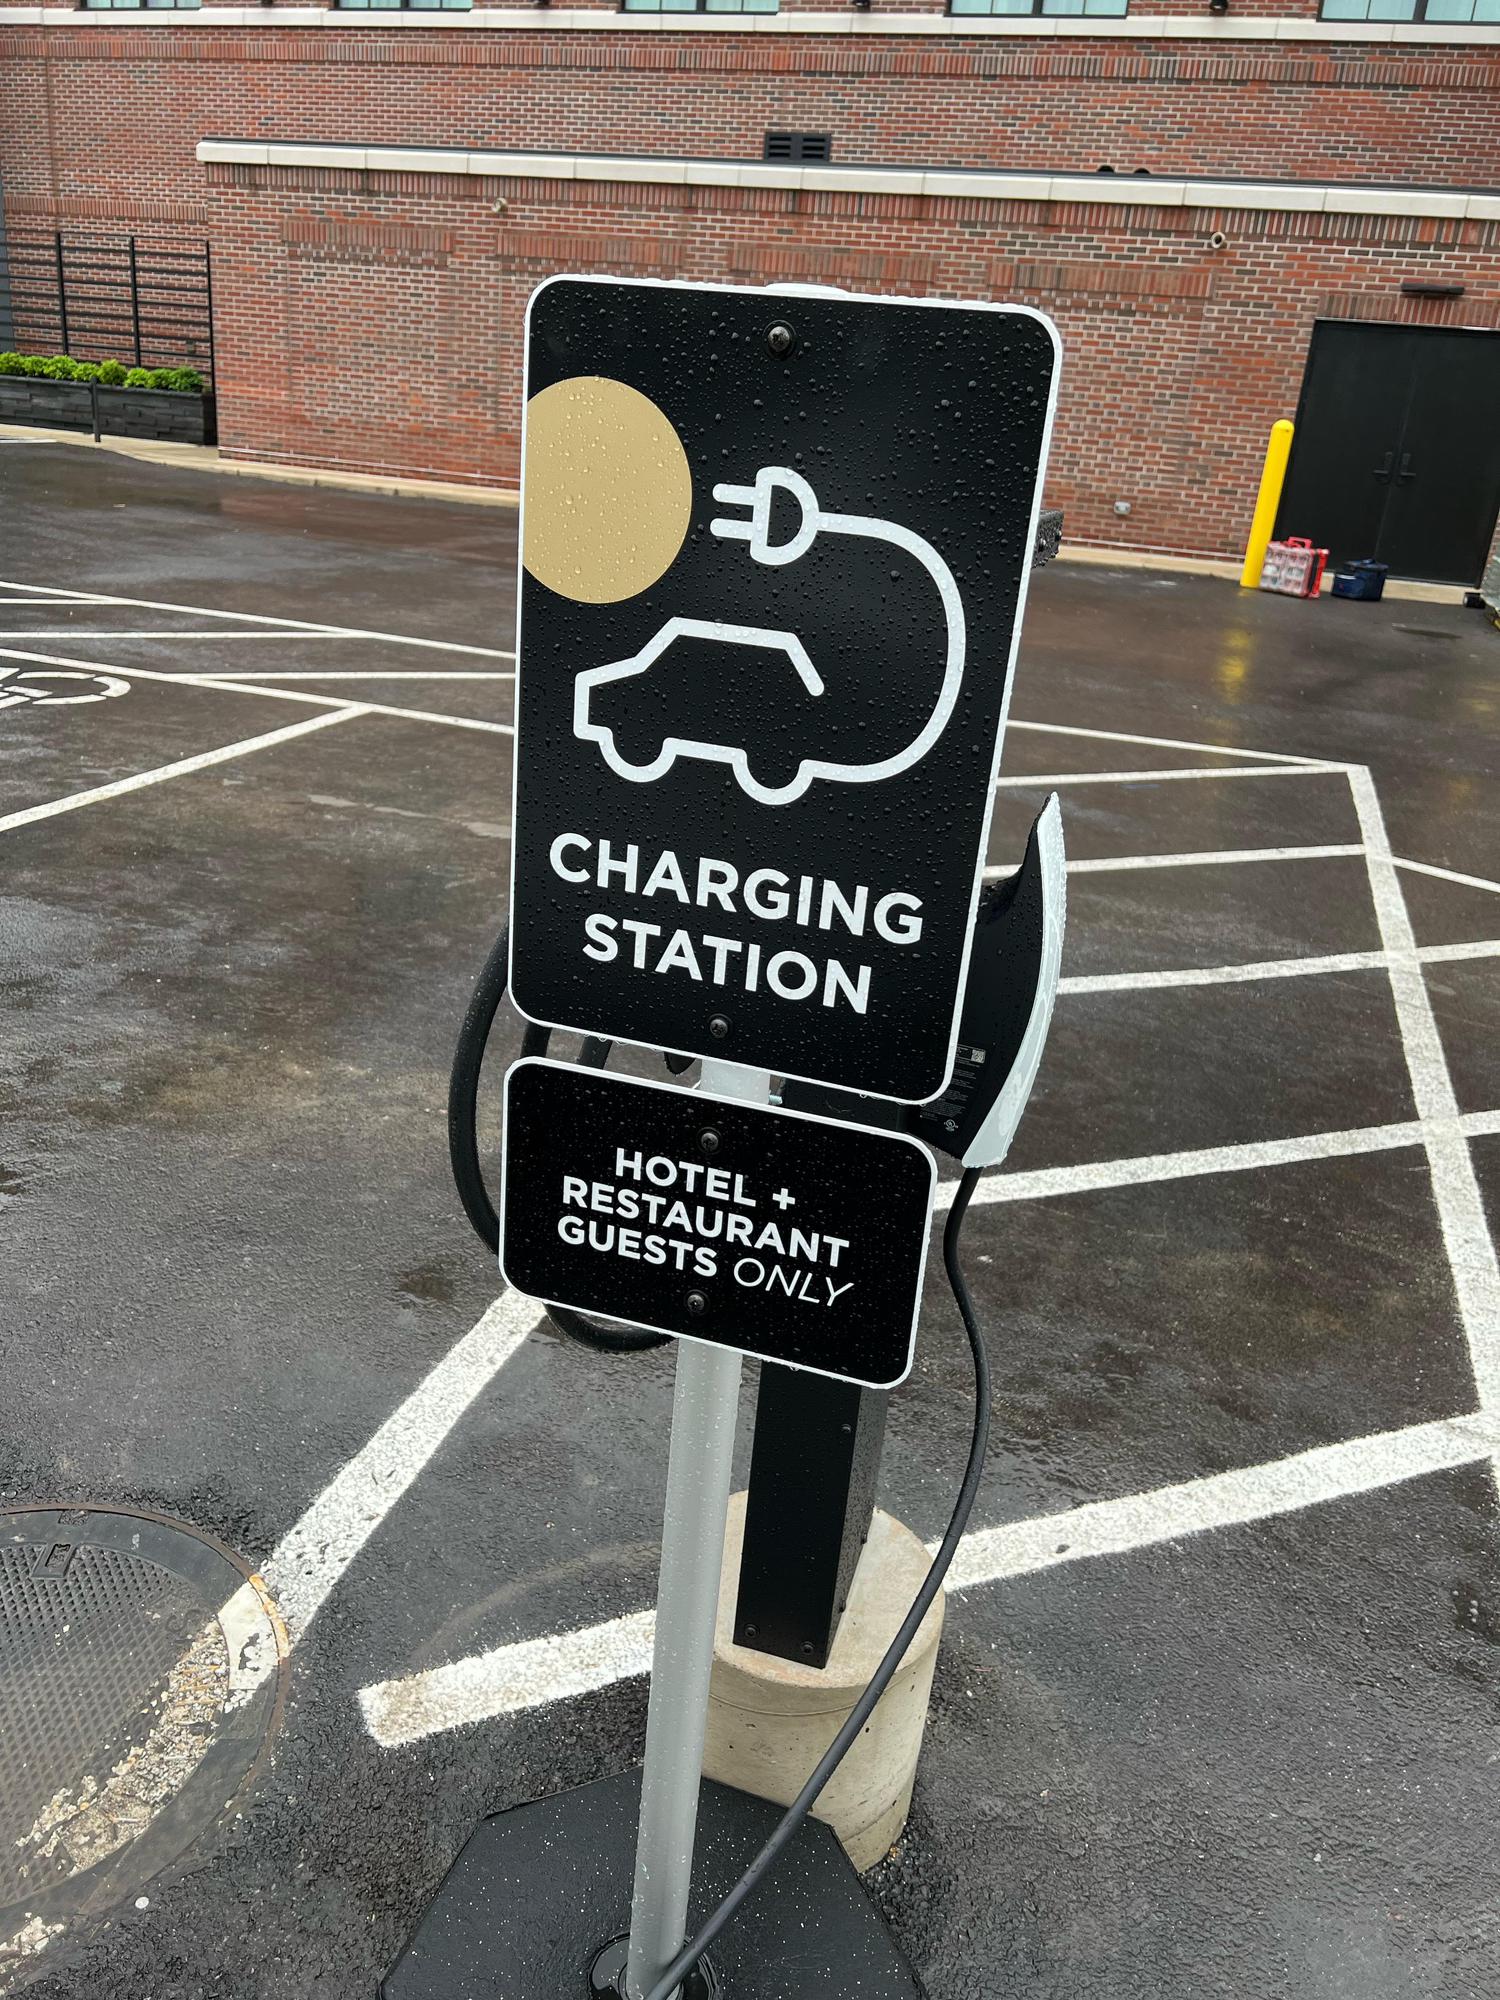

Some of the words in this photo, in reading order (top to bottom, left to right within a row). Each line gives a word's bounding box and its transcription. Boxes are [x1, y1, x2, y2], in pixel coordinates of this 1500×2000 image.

[550, 833, 923, 944] CHARGING
[583, 914, 872, 1014] STATION
[563, 1176, 849, 1267] RESTAURANT
[616, 1148, 756, 1207] HOTEL
[773, 1188, 795, 1210] +
[558, 1216, 717, 1276] GUESTS
[733, 1258, 854, 1306] ONLY
